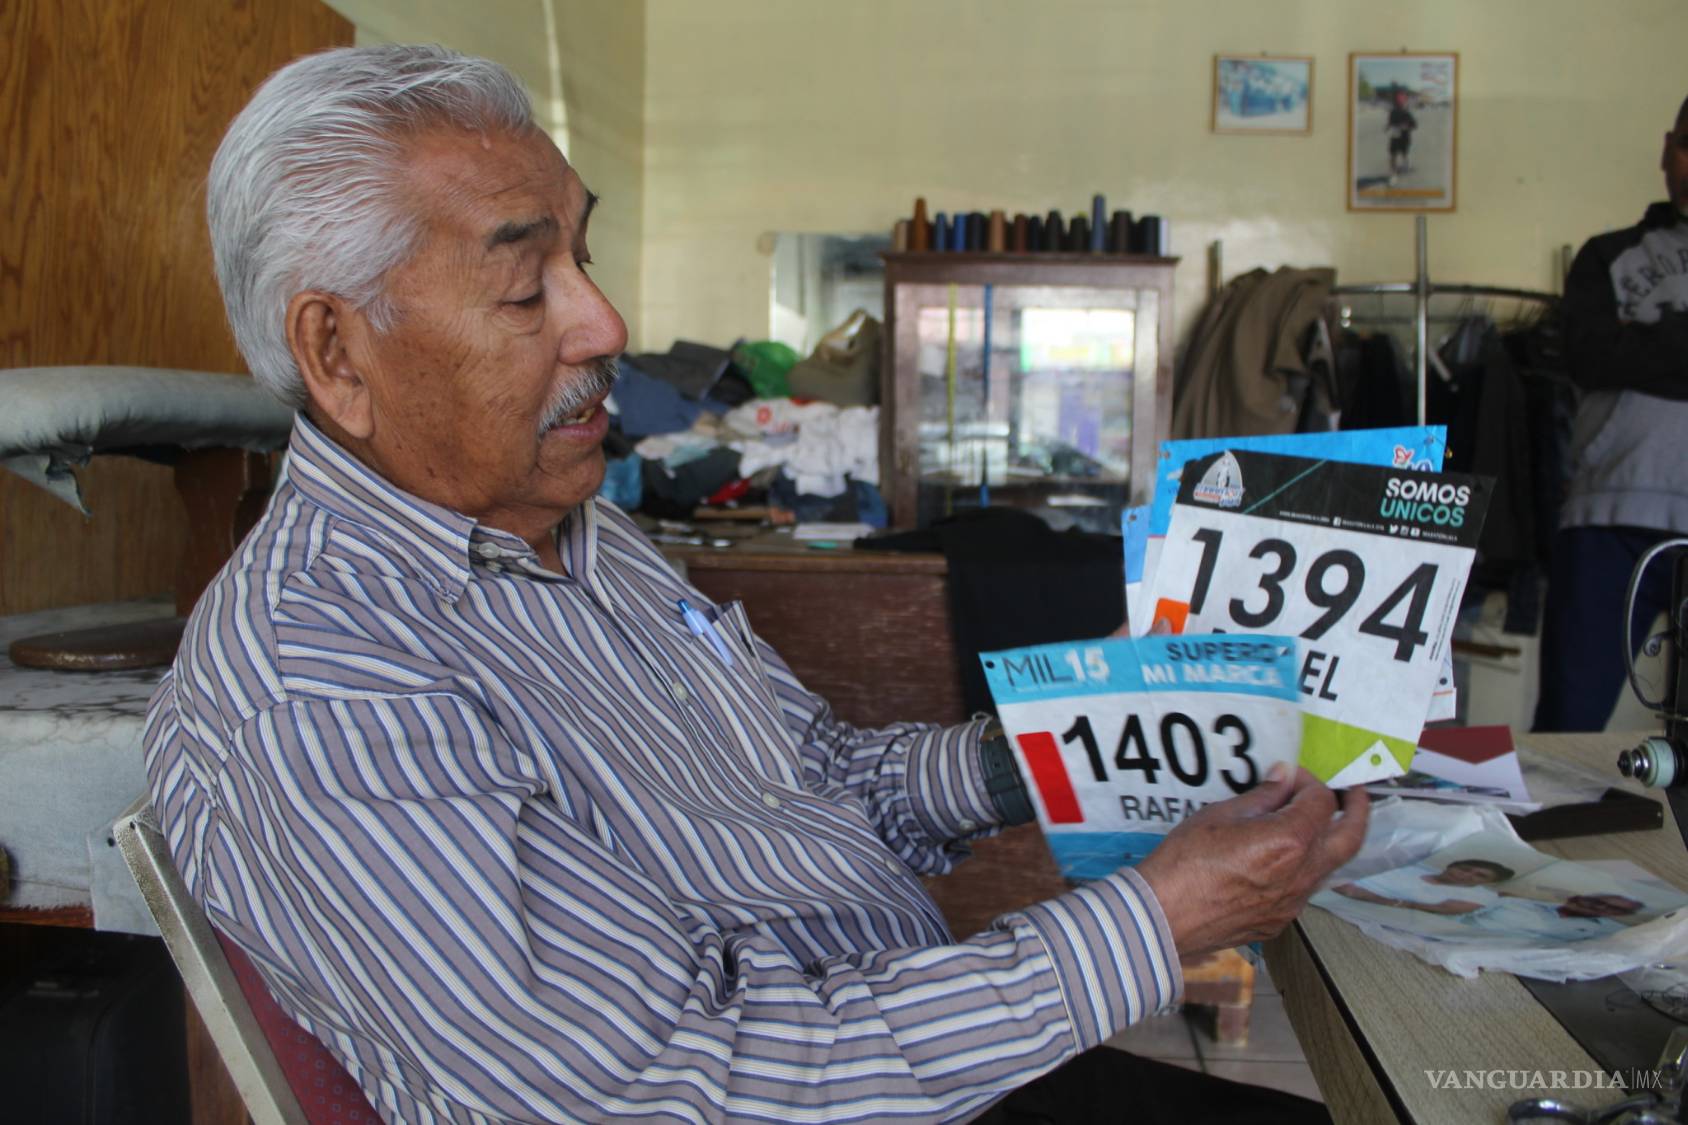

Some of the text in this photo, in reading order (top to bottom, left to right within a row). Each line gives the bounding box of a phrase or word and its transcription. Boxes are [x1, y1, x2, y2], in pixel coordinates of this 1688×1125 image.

[1385, 476, 1471, 506] SOMOS
[1380, 499, 1465, 528] UNICOS
[1188, 527, 1440, 662] 1394
[1140, 662, 1284, 688] MI MARCA
[1298, 649, 1340, 702] EL
[1061, 711, 1260, 795] 1403
[1119, 794, 1211, 823] RAFA
